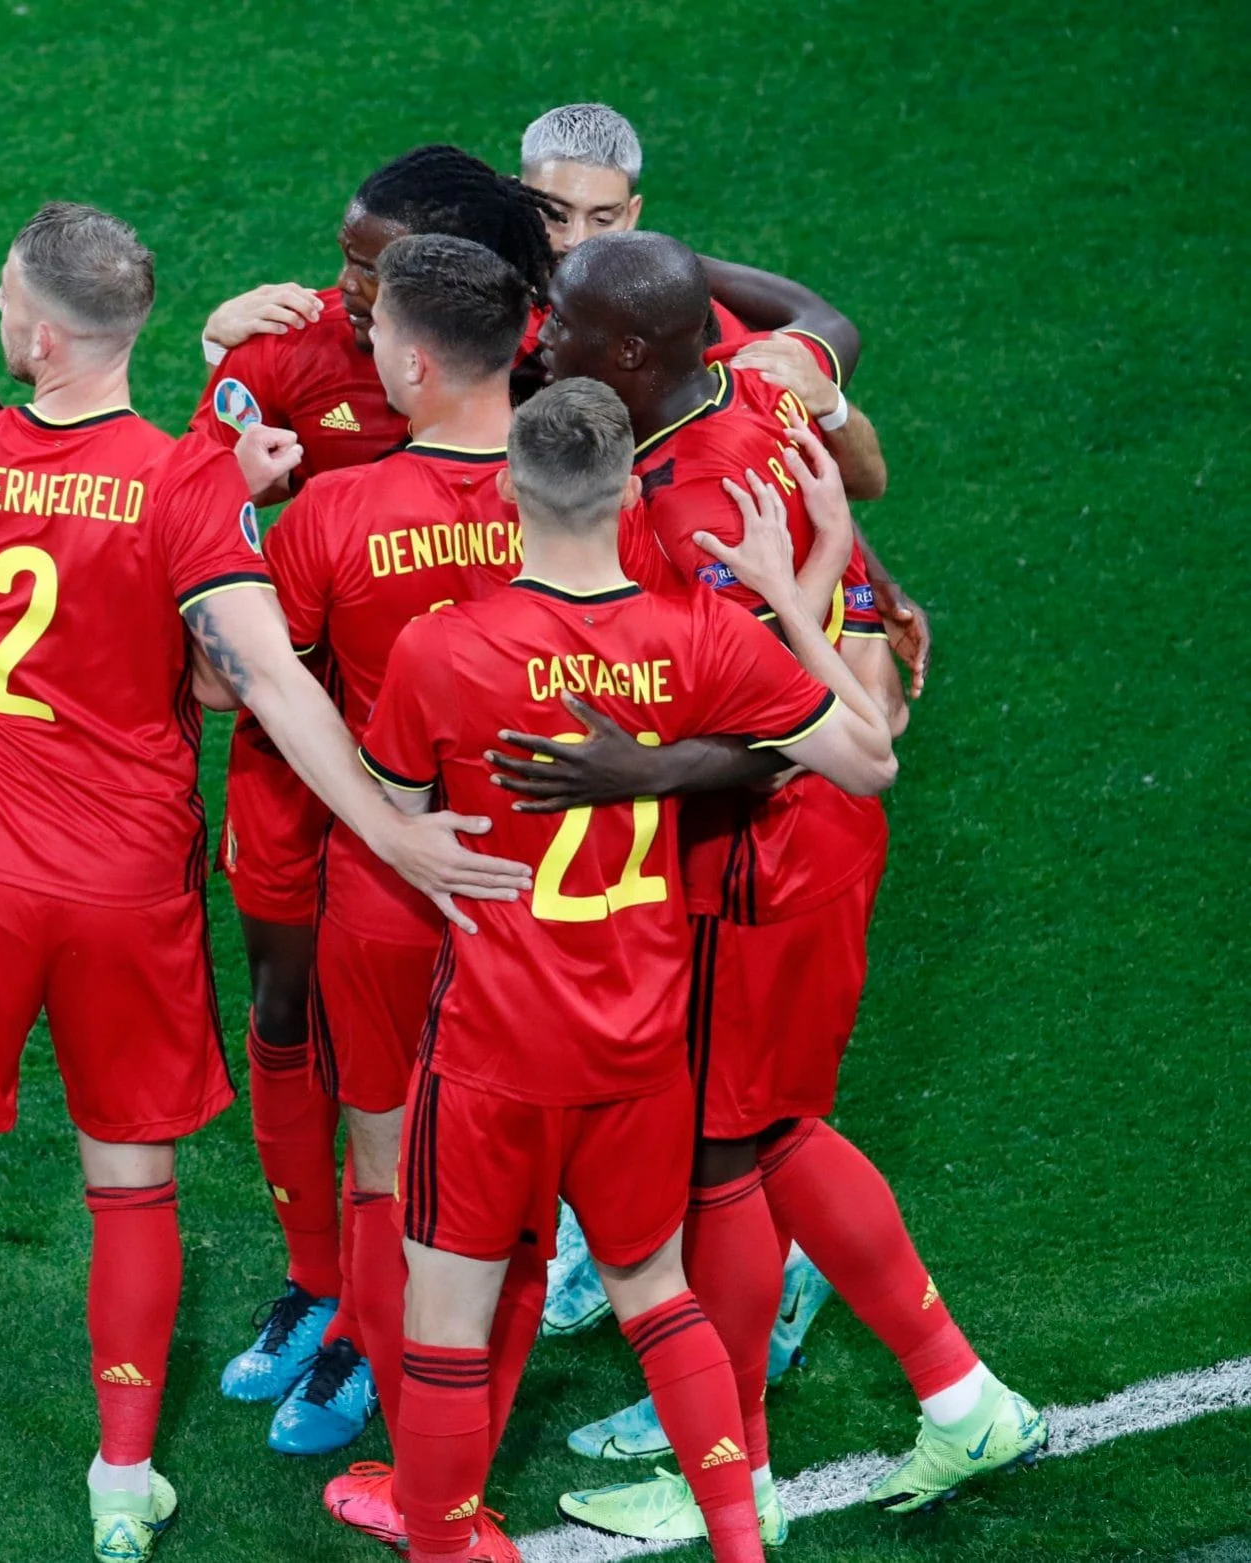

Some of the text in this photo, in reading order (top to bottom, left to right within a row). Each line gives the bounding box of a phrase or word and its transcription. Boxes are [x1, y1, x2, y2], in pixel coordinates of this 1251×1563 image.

[320, 416, 361, 432] adidas
[527, 654, 673, 704] CASTAGNE
[100, 1372, 152, 1386] adidas
